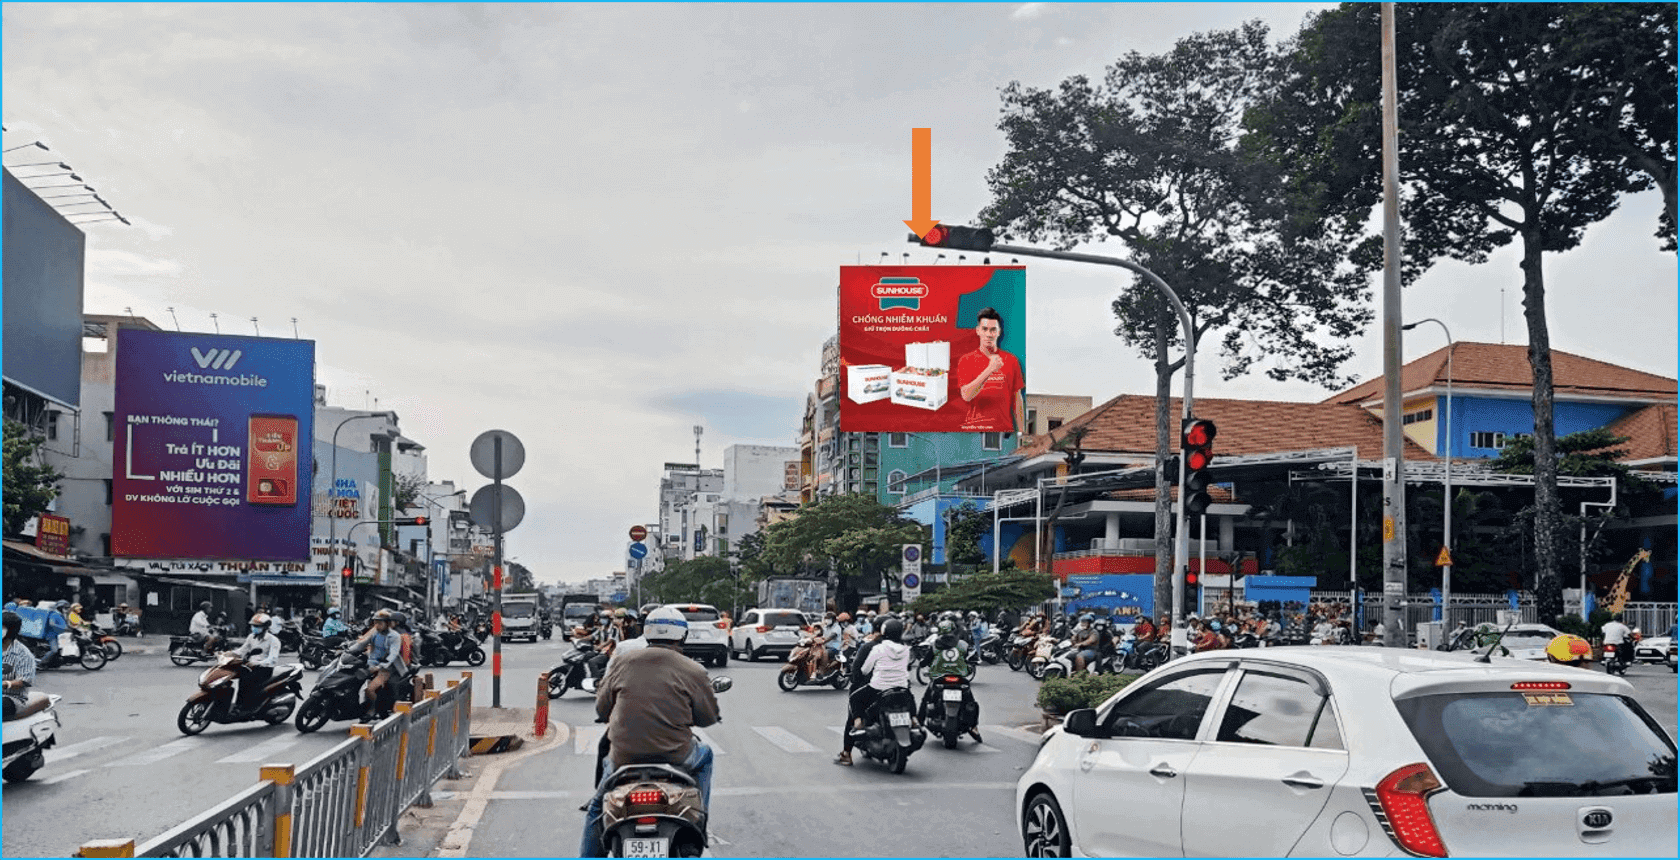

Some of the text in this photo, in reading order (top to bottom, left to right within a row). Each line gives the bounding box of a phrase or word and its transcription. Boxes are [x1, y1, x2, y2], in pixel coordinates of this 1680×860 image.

[876, 286, 924, 295] SUNHOUSE
[852, 313, 948, 323] CHỐNG NHIỄM KHUẨN
[163, 370, 267, 387] vietnamobile
[127, 415, 219, 427] BẠN THÔNG THÁI?
[166, 441, 241, 457] Trả ÍT HƠN
[195, 457, 241, 470] Ưu Đãi
[207, 472, 241, 484] HƠN
[166, 484, 241, 496] VỚI SIM THỨ 2 &
[125, 493, 140, 502] DV
[140, 493, 176, 503] KHÔNG
[192, 496, 221, 507] CUỘC
[221, 498, 241, 508] GỌI
[1467, 804, 1518, 814] morning
[1588, 814, 1610, 825] KIA
[631, 841, 661, 853] 59-X1
